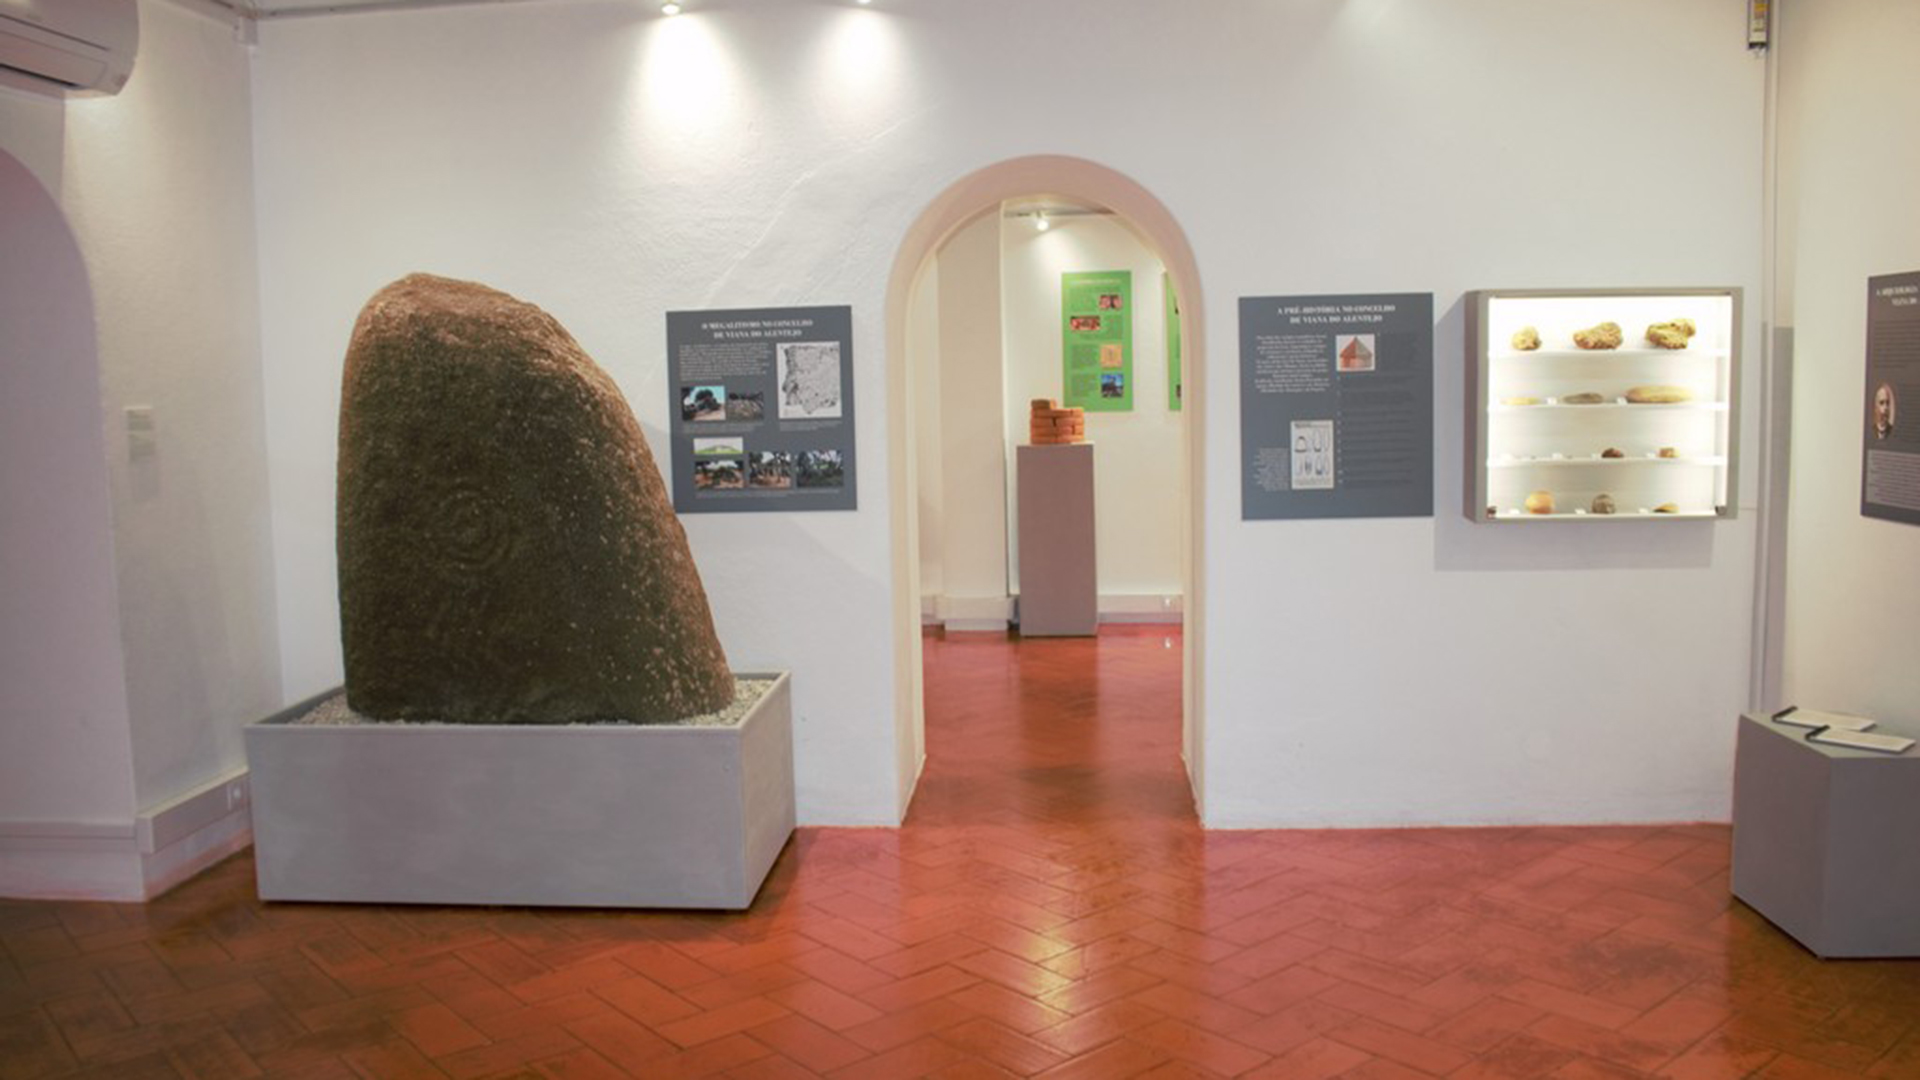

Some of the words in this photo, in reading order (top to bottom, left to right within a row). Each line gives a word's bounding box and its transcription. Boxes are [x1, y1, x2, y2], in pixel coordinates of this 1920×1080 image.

[1290, 316, 1301, 324] DE
[1302, 316, 1328, 324] VIANA
[1329, 315, 1342, 323] DO
[713, 331, 724, 339] DE
[725, 331, 750, 339] VIANA
